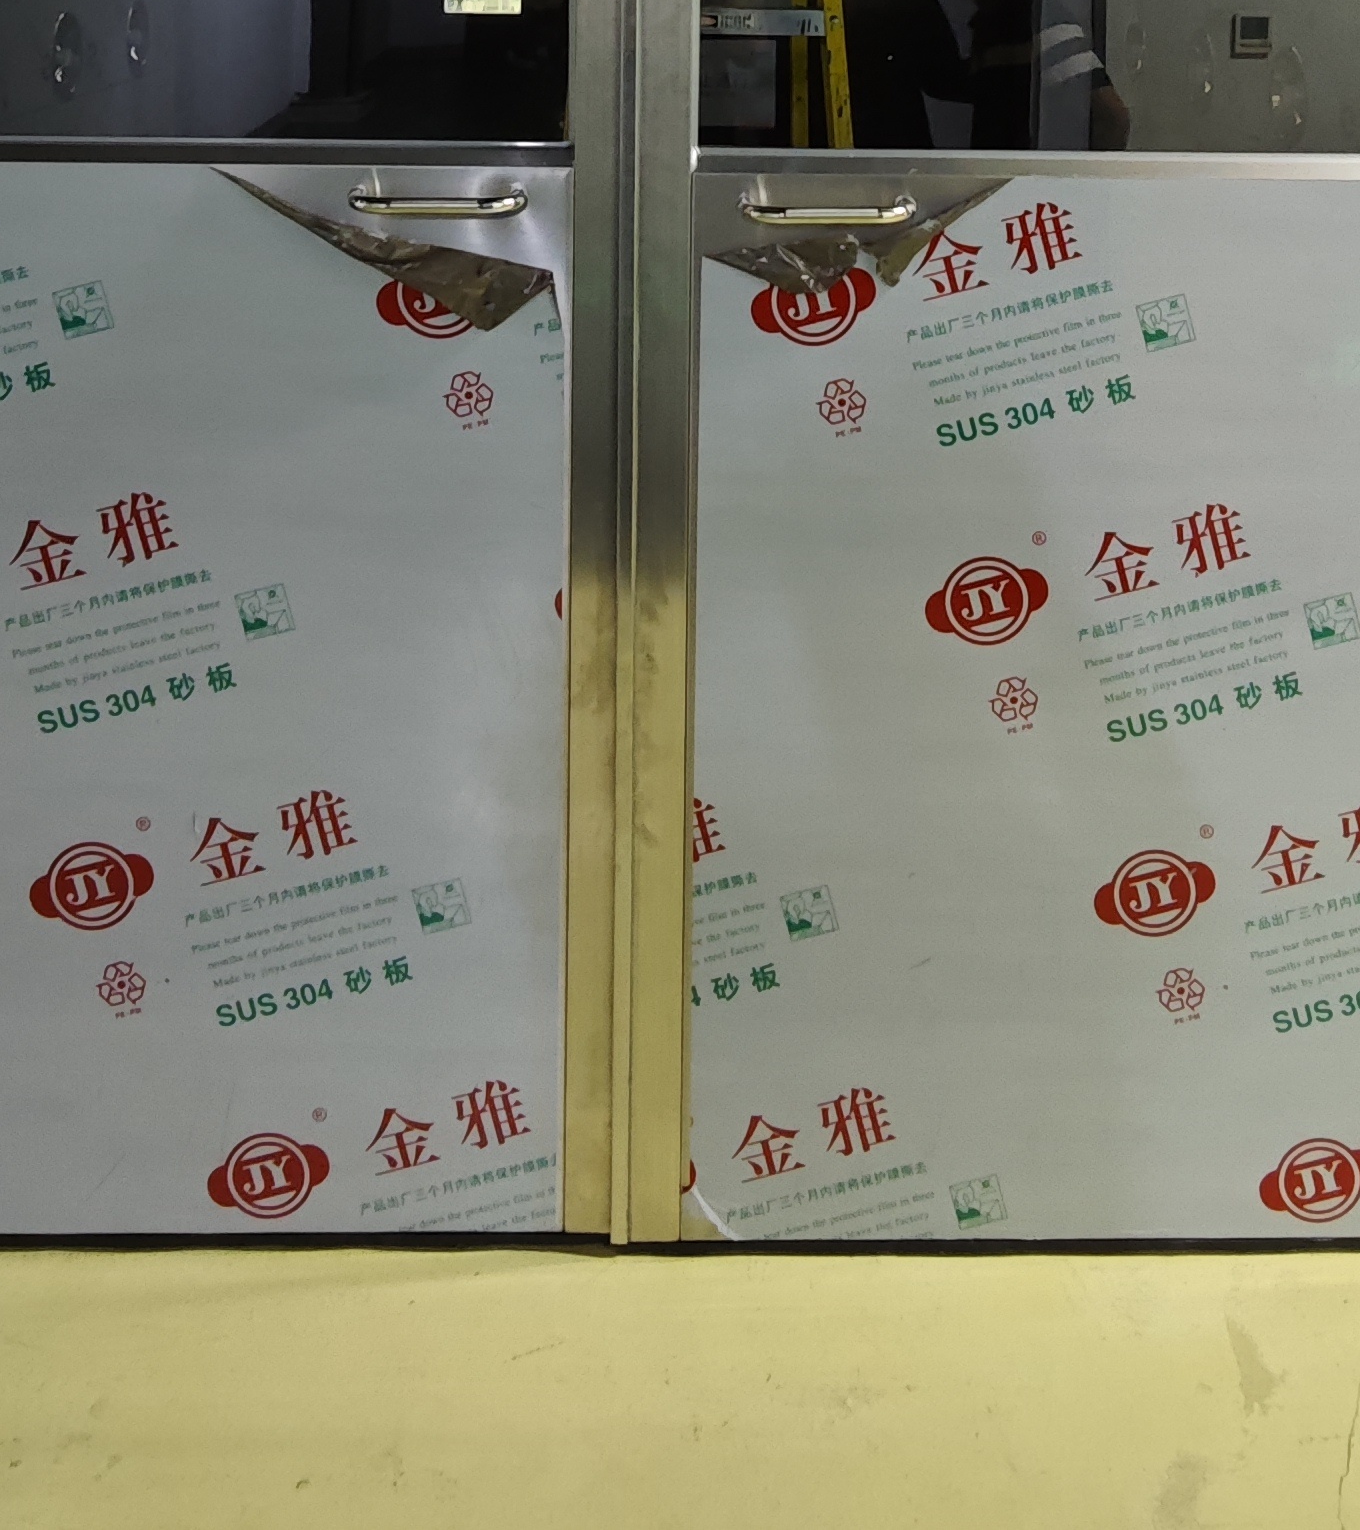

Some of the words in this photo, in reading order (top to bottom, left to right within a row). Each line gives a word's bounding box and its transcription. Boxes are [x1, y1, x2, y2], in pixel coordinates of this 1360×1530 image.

[911, 200, 1083, 302] 金雅
[935, 411, 999, 447] SUS
[1004, 396, 1055, 429] 304
[8, 491, 179, 591] 金雅
[1083, 502, 1252, 602] 金雅
[959, 577, 1011, 622] JY
[36, 699, 100, 733] SUS
[104, 684, 156, 716] 304
[1105, 708, 1168, 742] SUS
[1173, 693, 1224, 725] 304
[188, 788, 358, 887] 金雅
[64, 863, 117, 907] JY
[1127, 870, 1179, 914] JY
[215, 992, 277, 1027] SUS
[282, 977, 333, 1009] 304
[1271, 999, 1333, 1033] SUS
[364, 1078, 532, 1177] 金雅
[730, 1086, 897, 1184] 金雅
[241, 1153, 293, 1196] JY
[1292, 1157, 1343, 1201] JY
